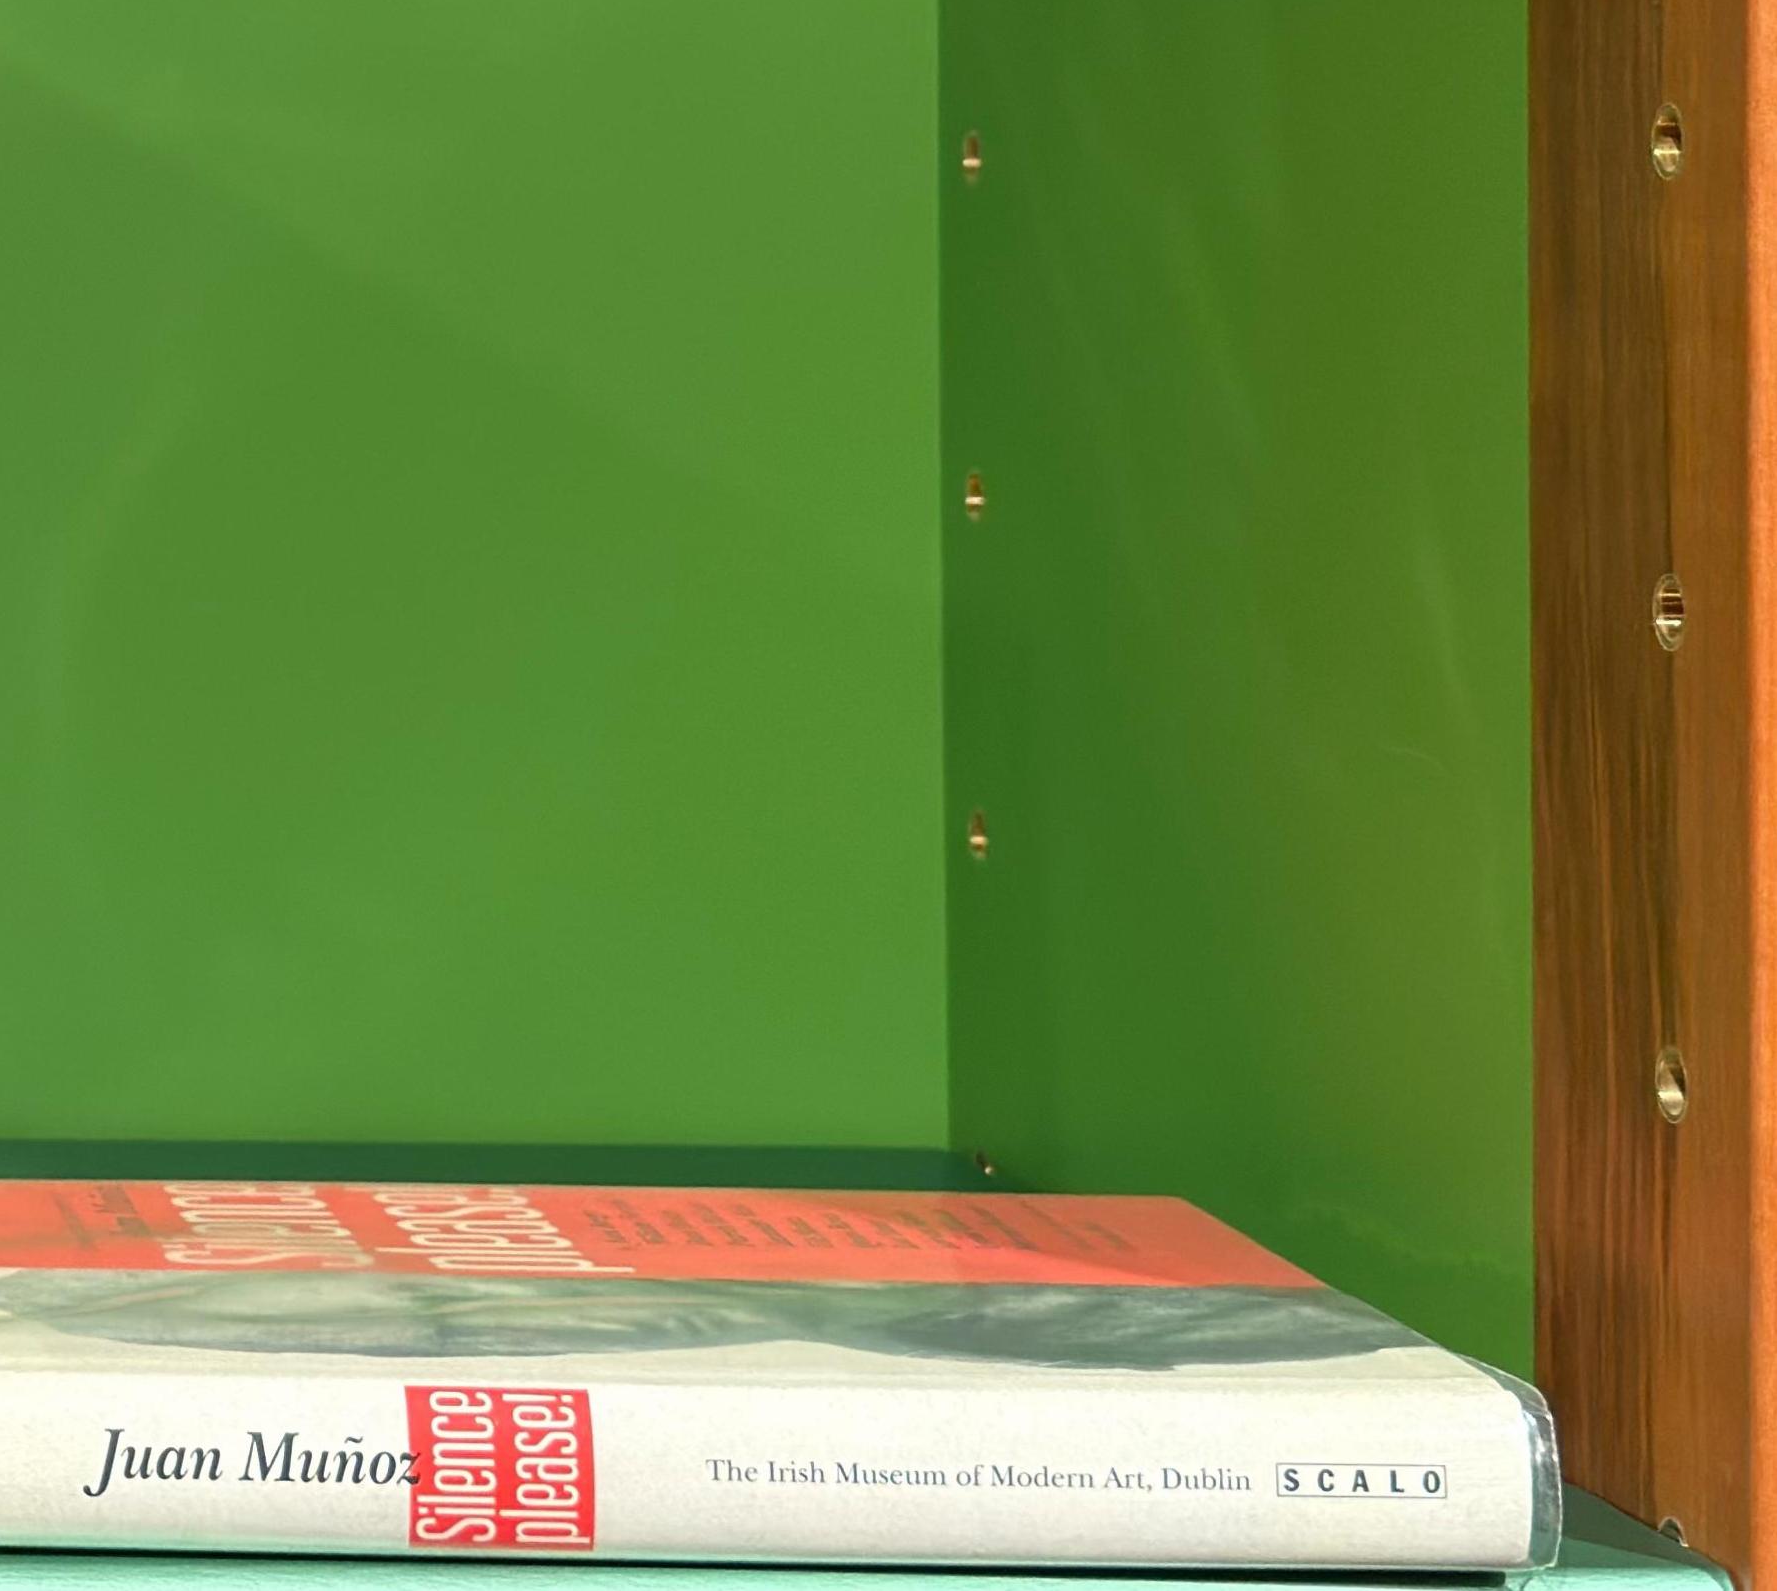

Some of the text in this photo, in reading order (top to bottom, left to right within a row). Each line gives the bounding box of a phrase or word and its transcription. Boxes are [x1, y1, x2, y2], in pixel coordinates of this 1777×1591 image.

[83, 1426, 421, 1497] Juan Muñoz
[417, 1389, 497, 1545] Silence
[499, 1390, 591, 1545] please!
[706, 1458, 1252, 1494] The Irish Museum of Modern Art, Dublin
